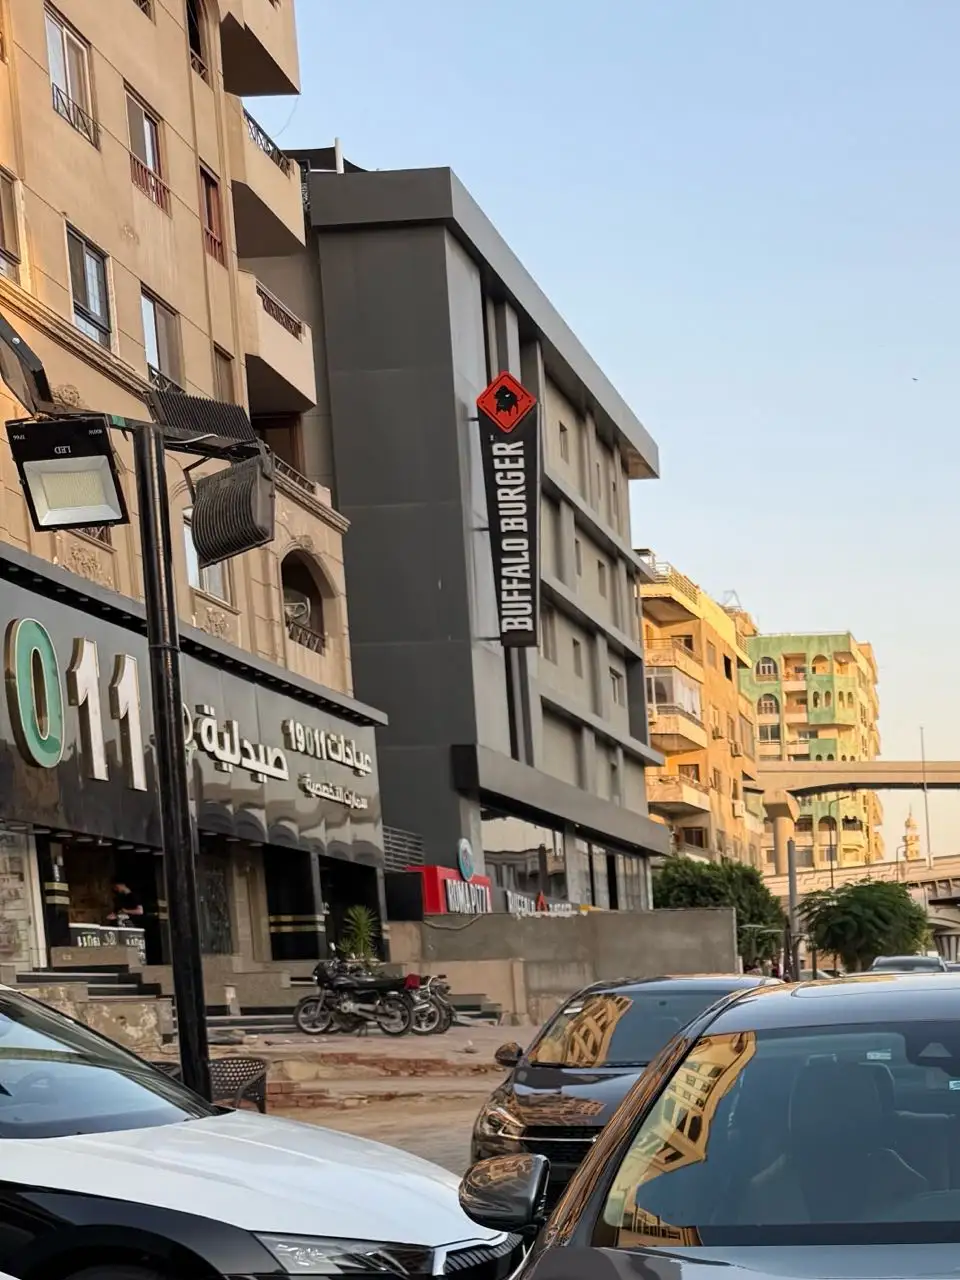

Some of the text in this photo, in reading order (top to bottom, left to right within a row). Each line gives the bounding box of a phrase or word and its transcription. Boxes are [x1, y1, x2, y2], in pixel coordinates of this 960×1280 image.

[54, 445, 72, 454] LED
[492, 440, 534, 632] BUFFALO BURGER
[195, 704, 289, 783] صيدلية
[282, 719, 372, 776] عيادات 19011
